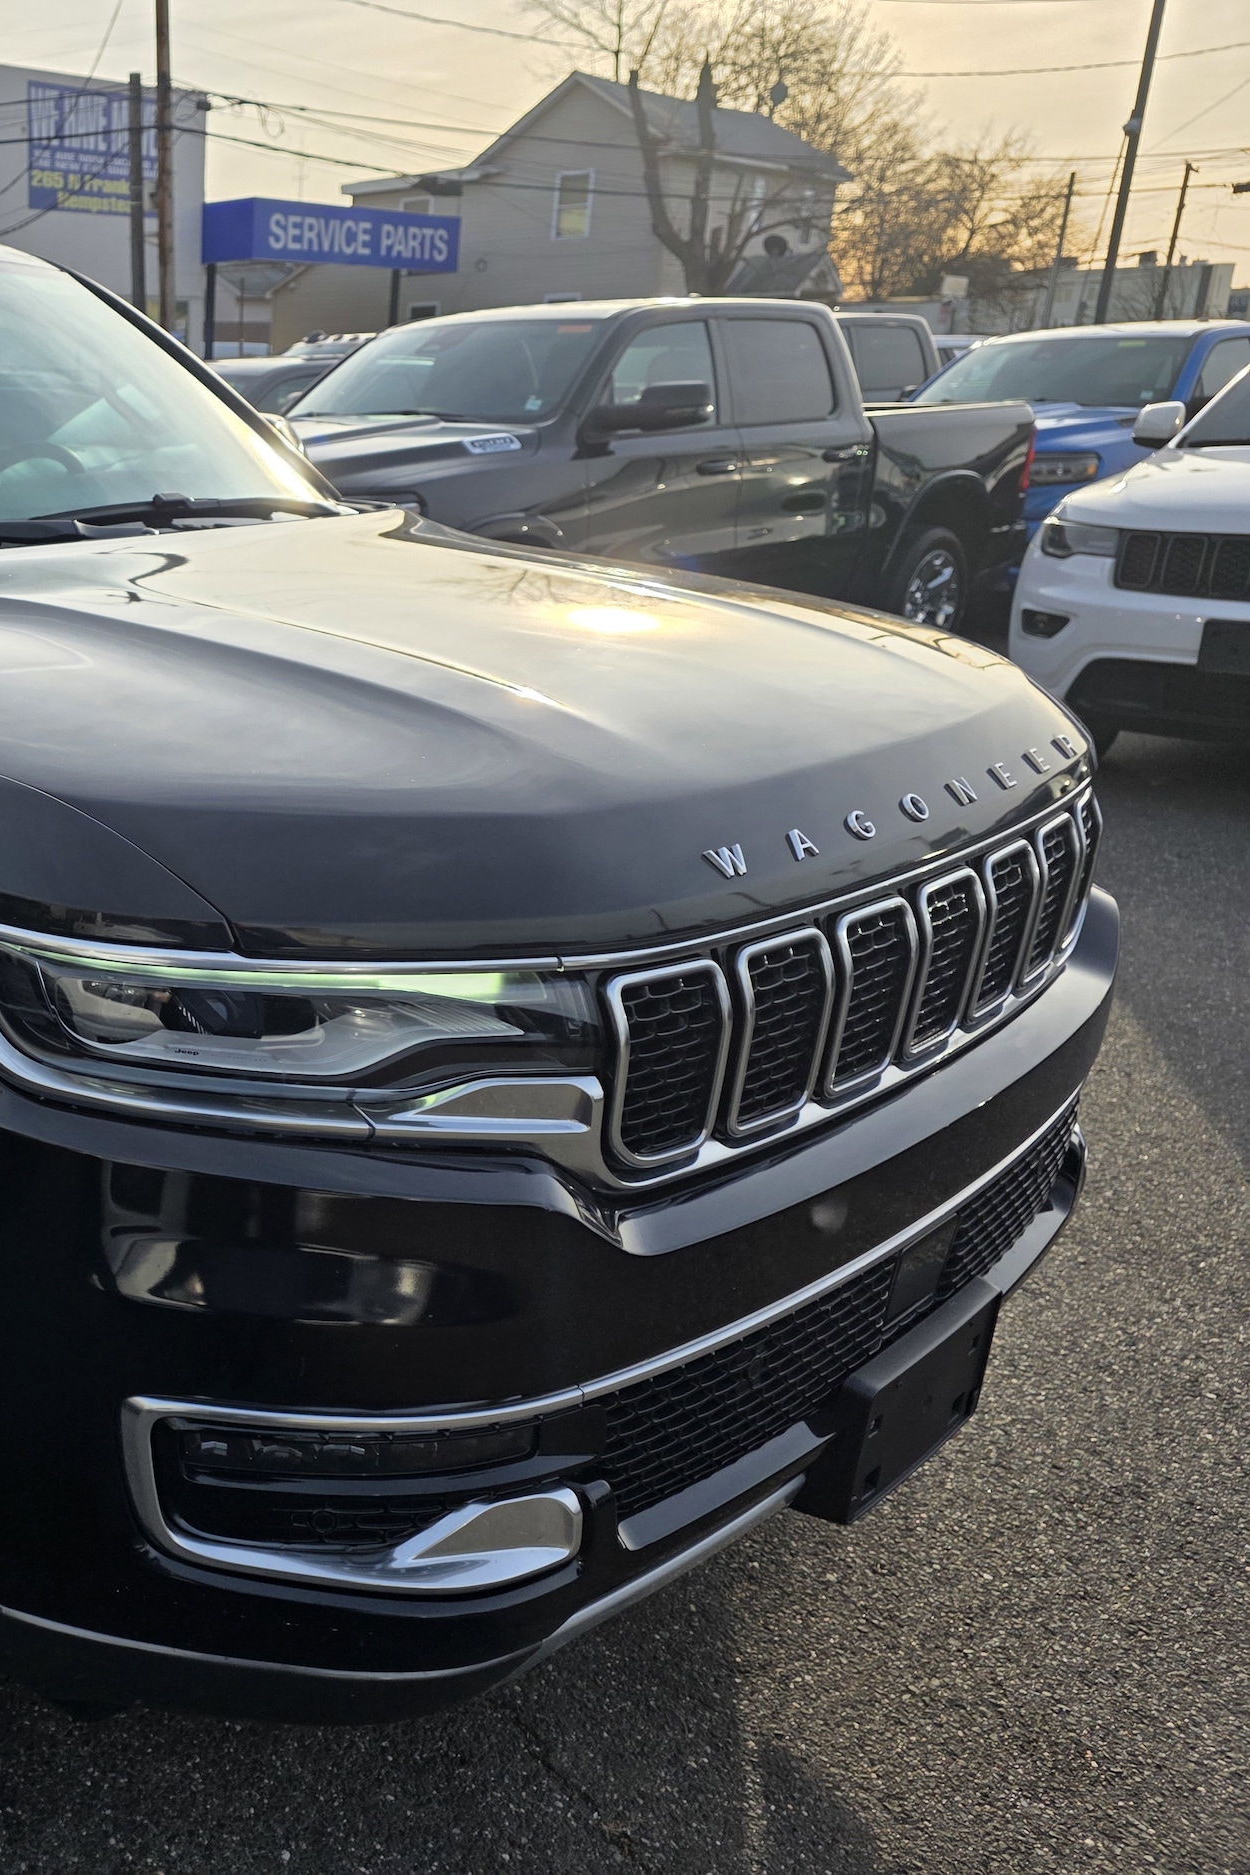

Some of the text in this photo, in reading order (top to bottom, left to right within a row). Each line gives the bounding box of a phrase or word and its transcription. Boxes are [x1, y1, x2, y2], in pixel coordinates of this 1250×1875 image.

[31, 169, 64, 189] 265
[269, 212, 449, 262] SERVICE PARTS
[701, 733, 1077, 880] WAGONEER
[174, 1048, 199, 1056] Jeep
